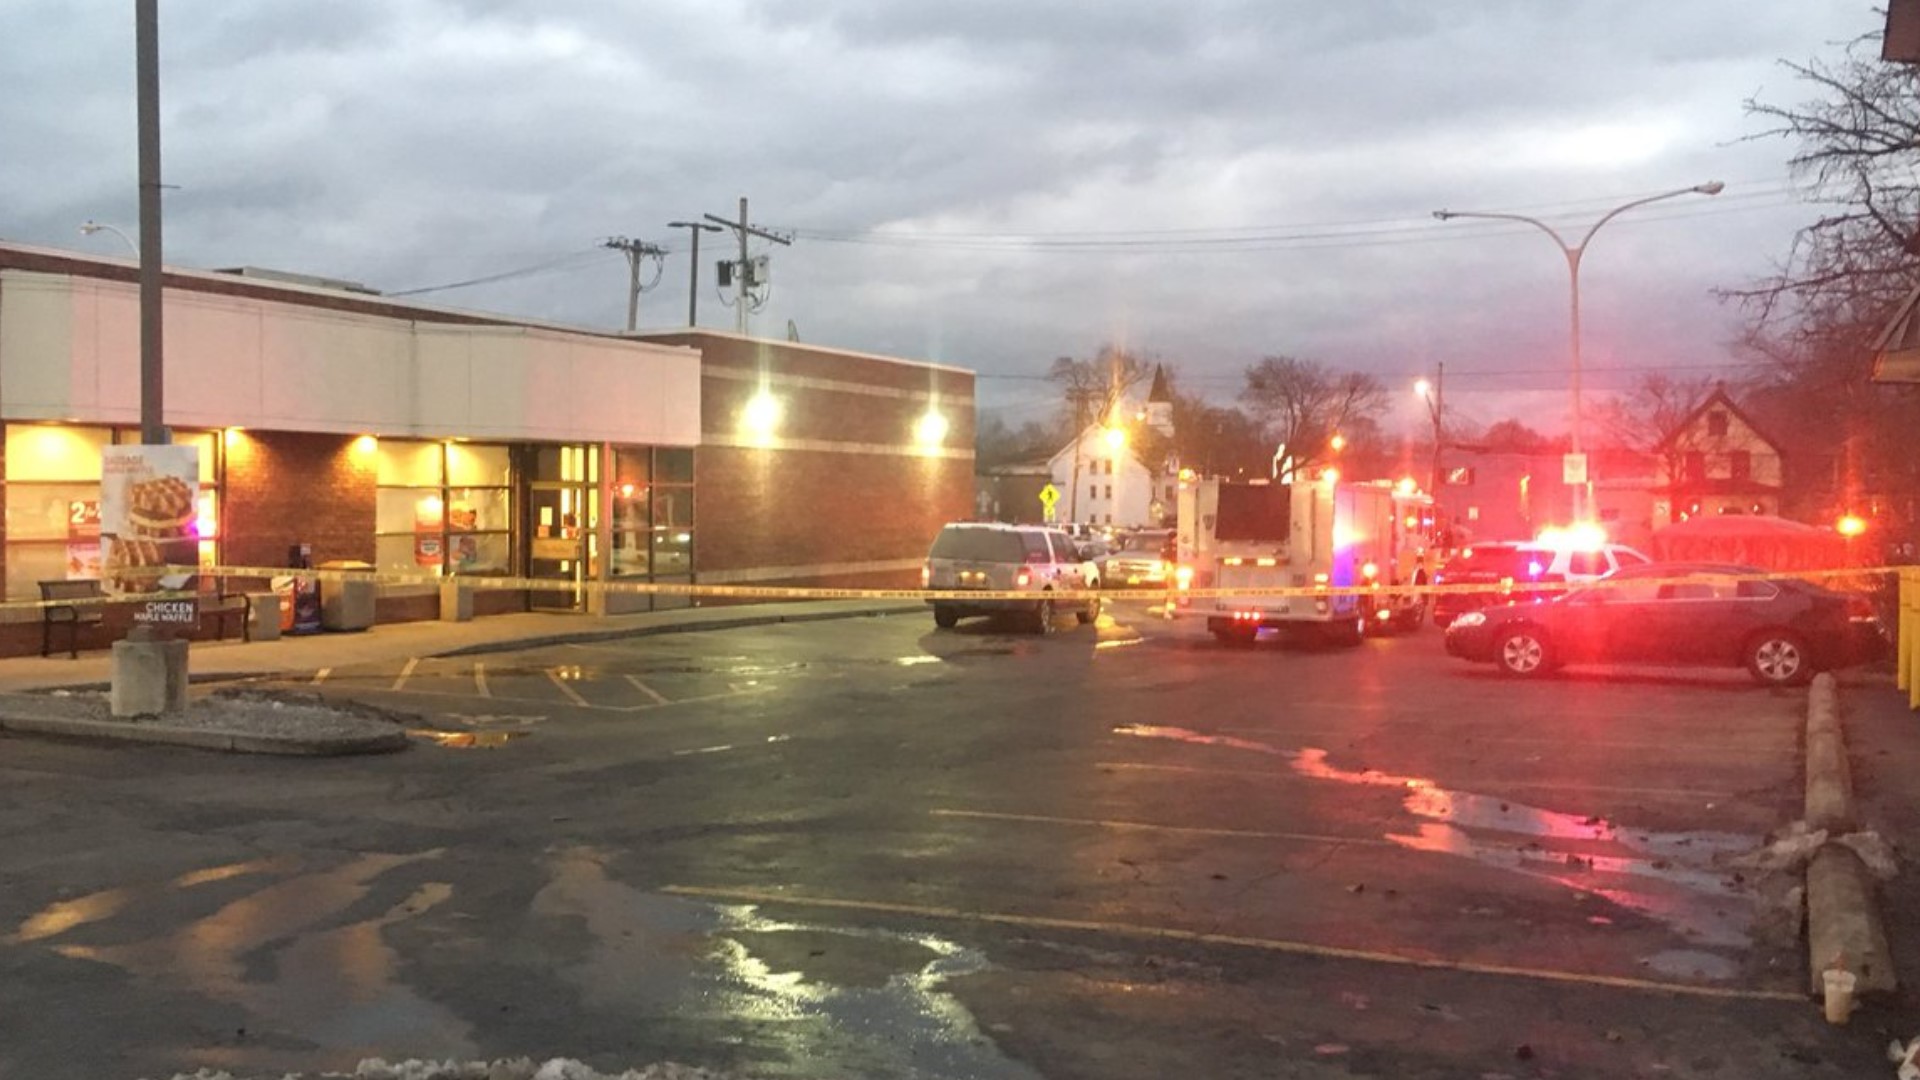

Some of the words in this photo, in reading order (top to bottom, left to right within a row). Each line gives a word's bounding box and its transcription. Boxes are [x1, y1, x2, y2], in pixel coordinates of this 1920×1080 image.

[71, 502, 85, 523] 2
[145, 602, 193, 613] CHICKEN
[134, 612, 160, 621] MAPLE
[161, 612, 193, 622] WAFFLE
